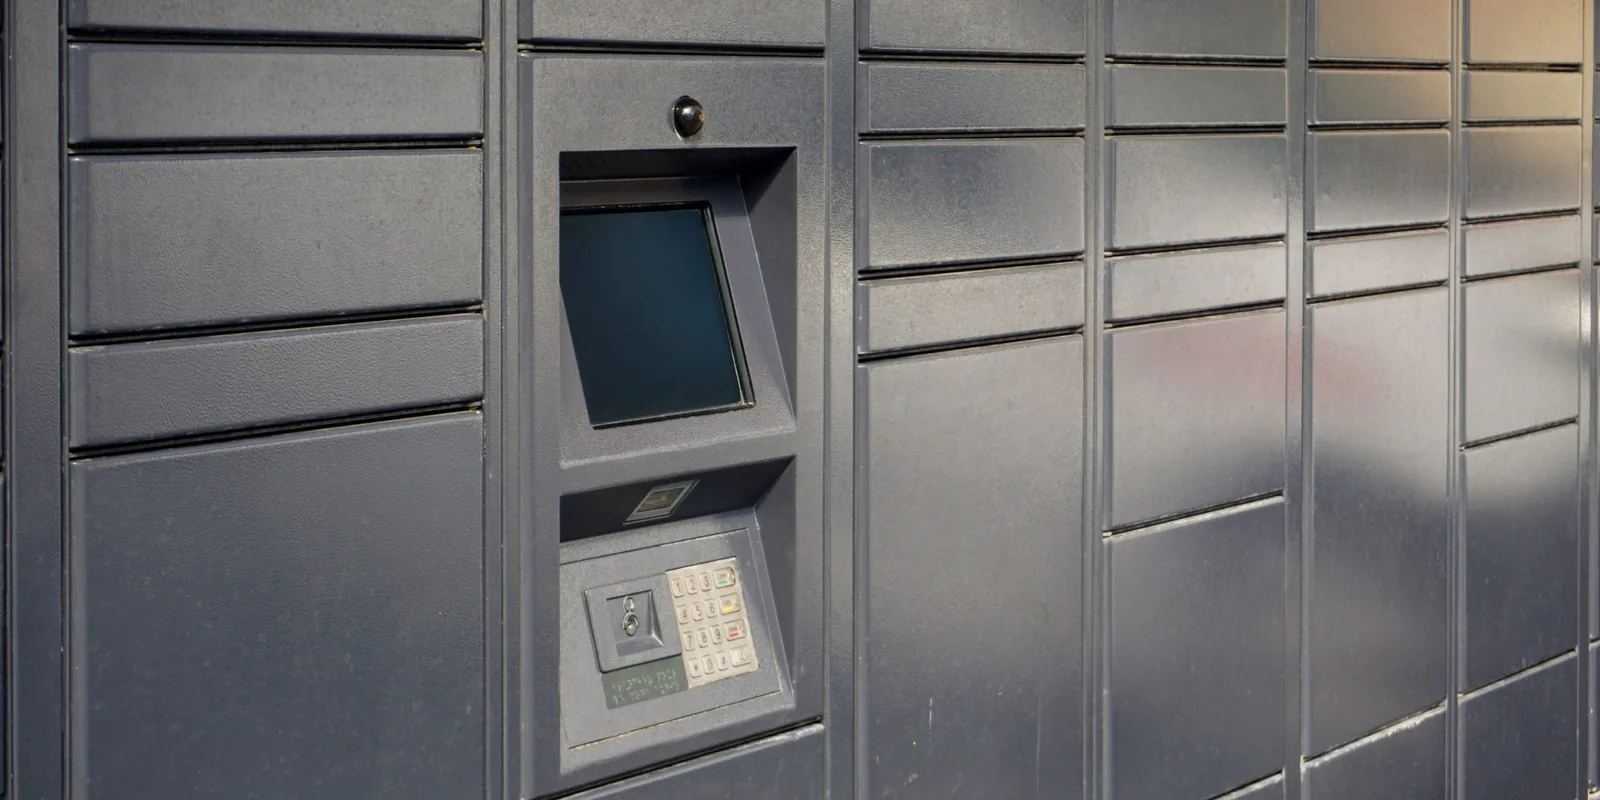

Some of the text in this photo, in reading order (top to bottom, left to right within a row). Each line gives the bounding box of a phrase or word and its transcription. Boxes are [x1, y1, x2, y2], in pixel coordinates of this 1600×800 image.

[676, 582, 681, 593] 1
[689, 579, 696, 590] 2
[703, 576, 710, 587] 3
[682, 609, 688, 619] 4
[695, 605, 701, 616] 5
[709, 602, 715, 614] 6
[687, 629, 721, 647] 7 8 9
